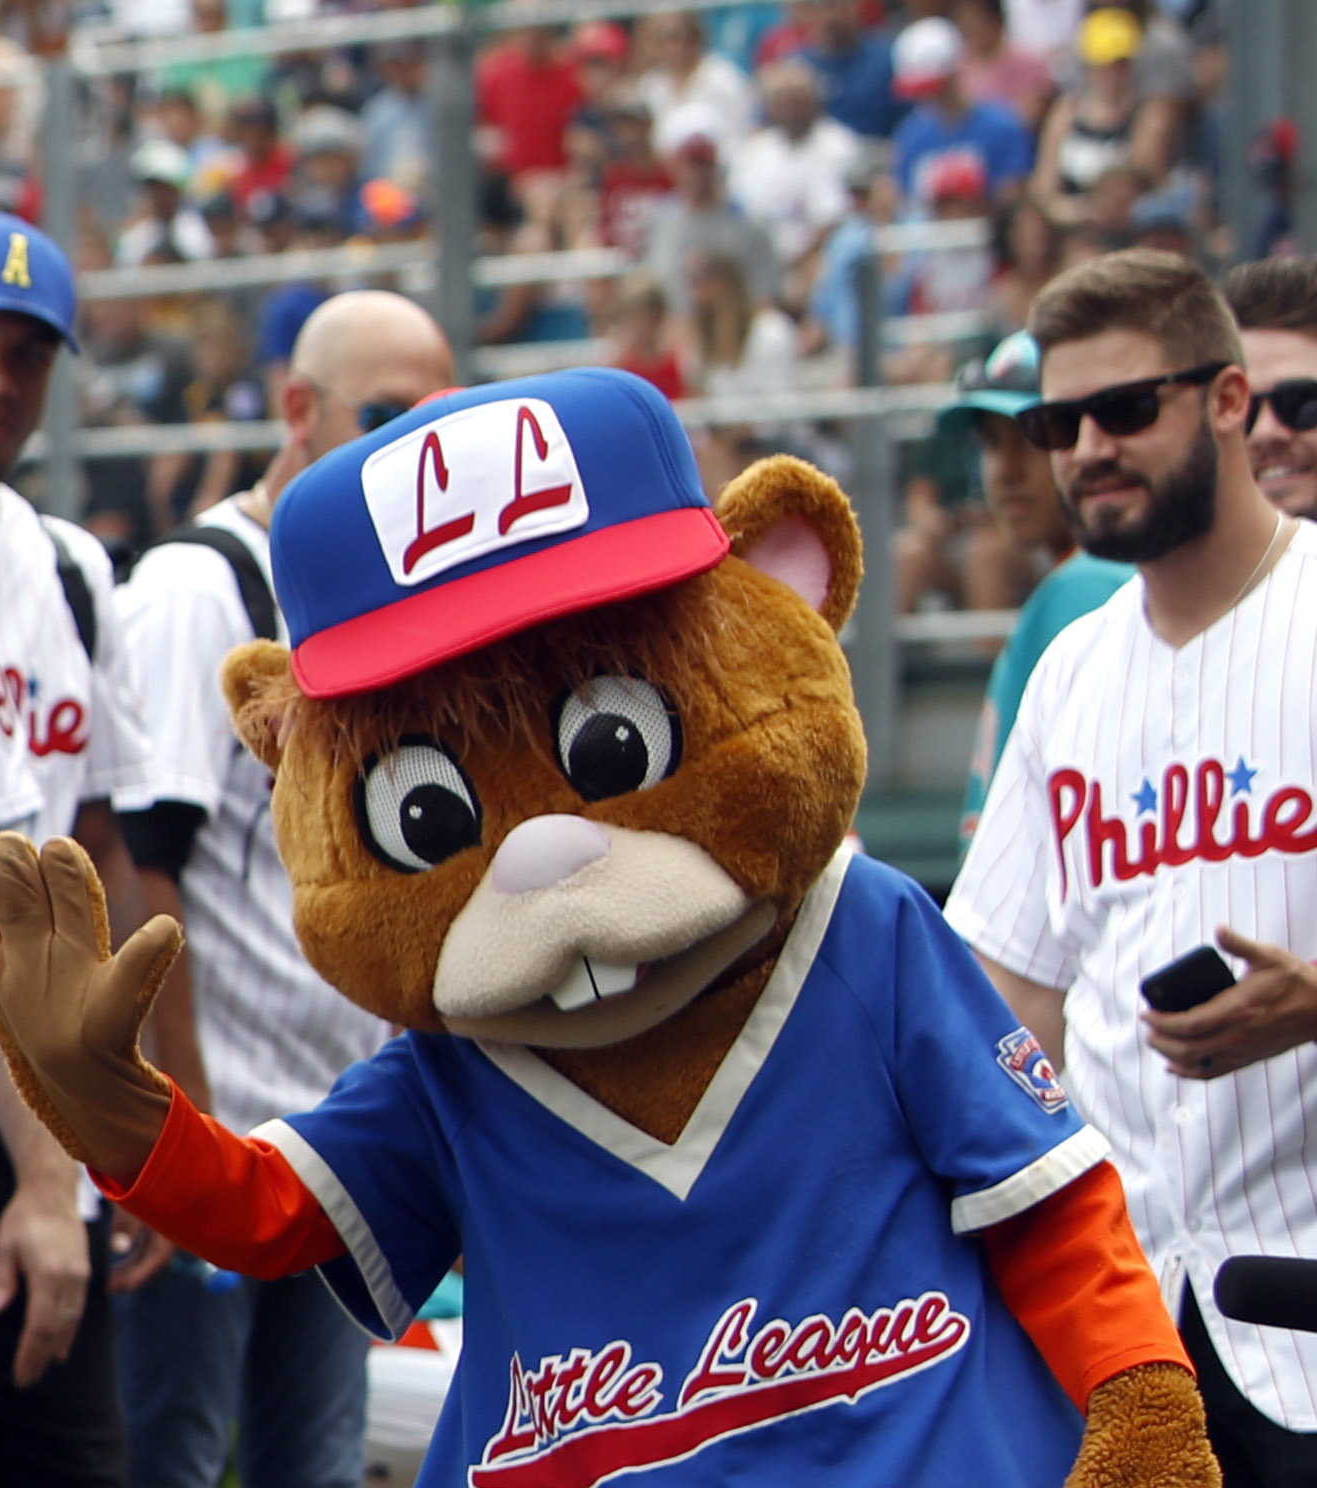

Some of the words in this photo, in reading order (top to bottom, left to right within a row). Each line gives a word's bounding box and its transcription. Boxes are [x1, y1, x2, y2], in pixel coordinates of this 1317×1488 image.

[1, 231, 32, 289] A
[402, 405, 573, 576] LL
[680, 1292, 966, 1406] League
